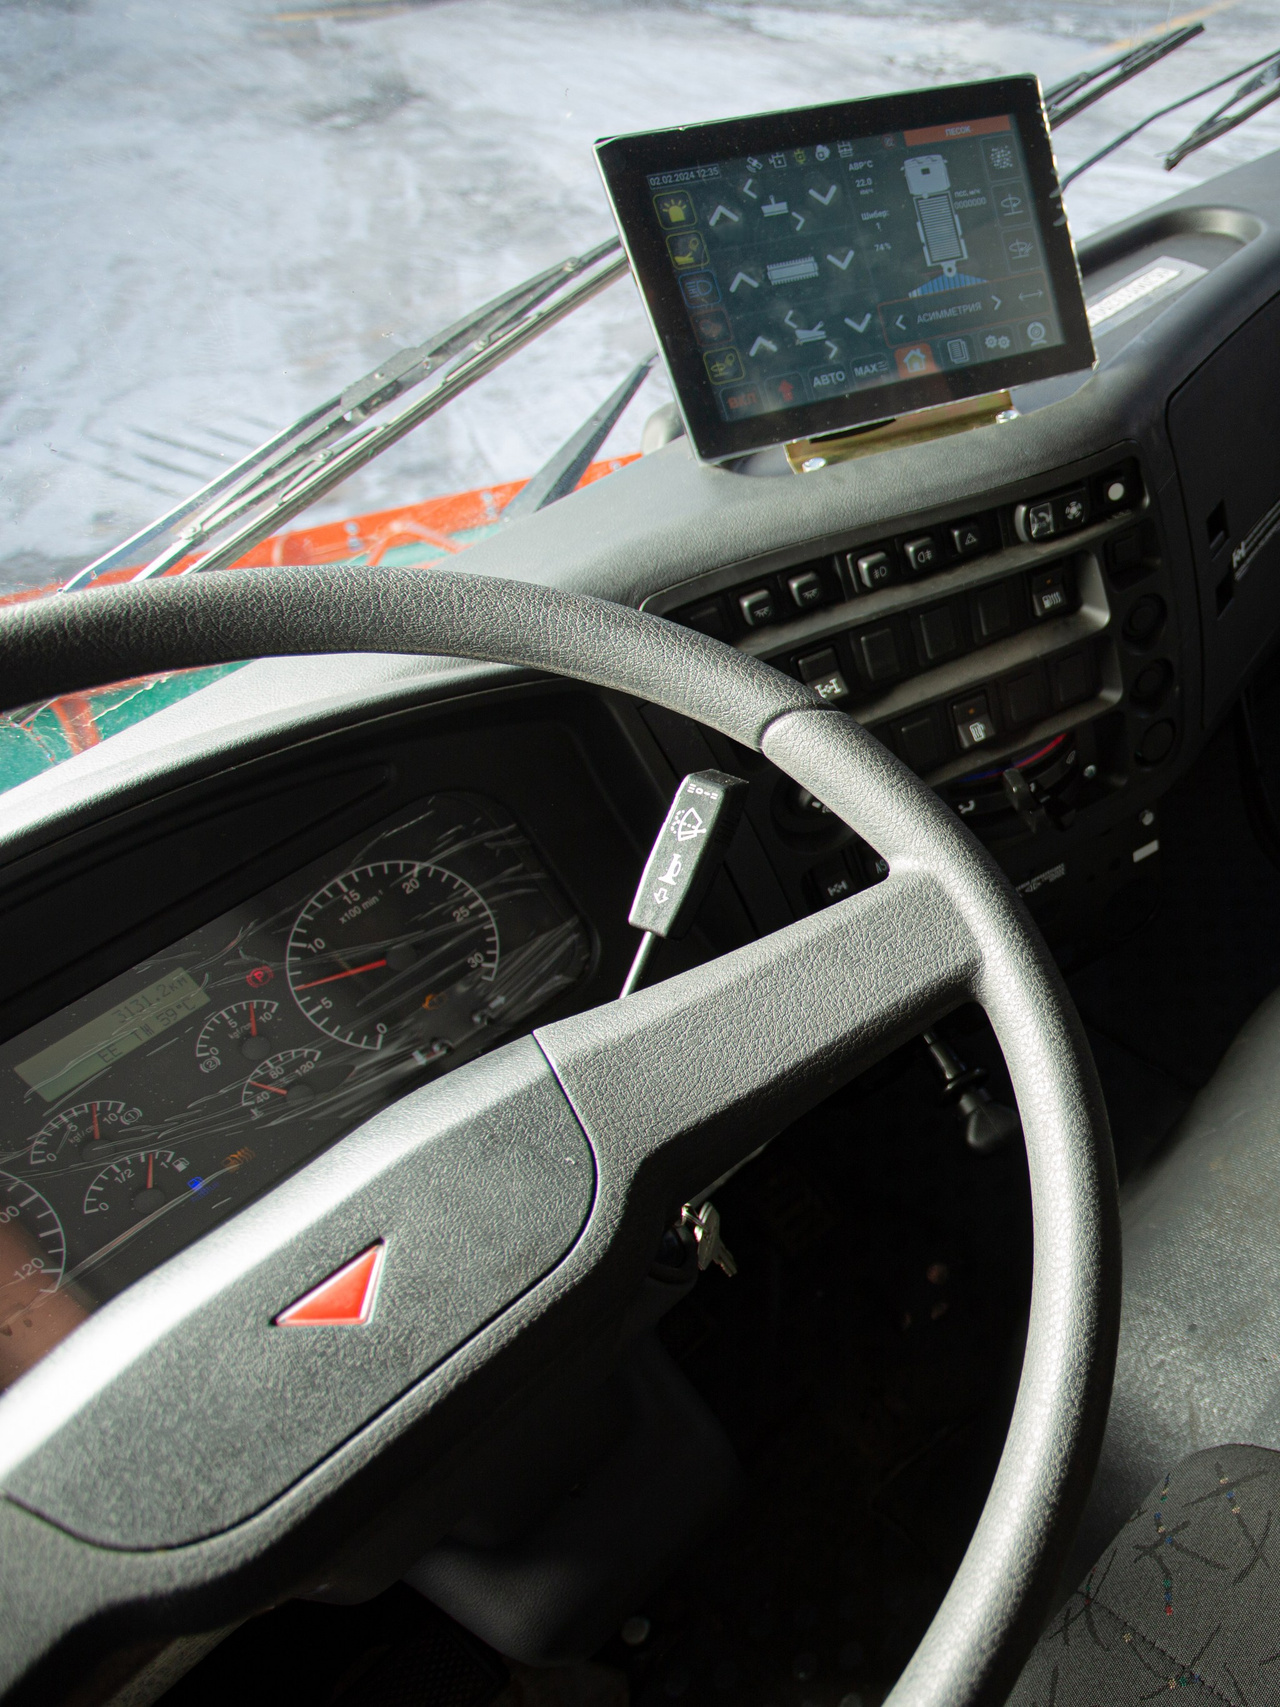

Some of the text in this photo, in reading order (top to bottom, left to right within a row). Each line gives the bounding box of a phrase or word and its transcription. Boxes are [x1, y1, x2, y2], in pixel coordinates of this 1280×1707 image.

[945, 125, 971, 136] ПЕСОК
[649, 171, 695, 186] 02.02.2024
[855, 177, 873, 188] 22.0
[917, 301, 983, 325] АСИММЕТРИЯ
[813, 370, 846, 388] АВТО
[875, 859, 888, 874] AS
[402, 877, 420, 895] 20
[342, 889, 361, 906] 15
[452, 907, 471, 923] 25
[306, 937, 326, 953] 10
[467, 952, 485, 969] 30
[321, 997, 333, 1010] 5
[227, 1018, 238, 1029] 5
[258, 1011, 272, 1024] 10
[376, 1022, 388, 1035] 0
[209, 1046, 220, 1056] 0
[269, 1065, 285, 1080] 80
[294, 1060, 316, 1078] 120
[256, 1090, 271, 1104] 40
[102, 1112, 119, 1126] 10
[46, 1152, 58, 1163] 0
[160, 1160, 169, 1169] 1
[113, 1167, 136, 1185] 1/2
[0, 1205, 20, 1224] 00
[98, 1202, 110, 1212] 0
[13, 1257, 45, 1280] 120
